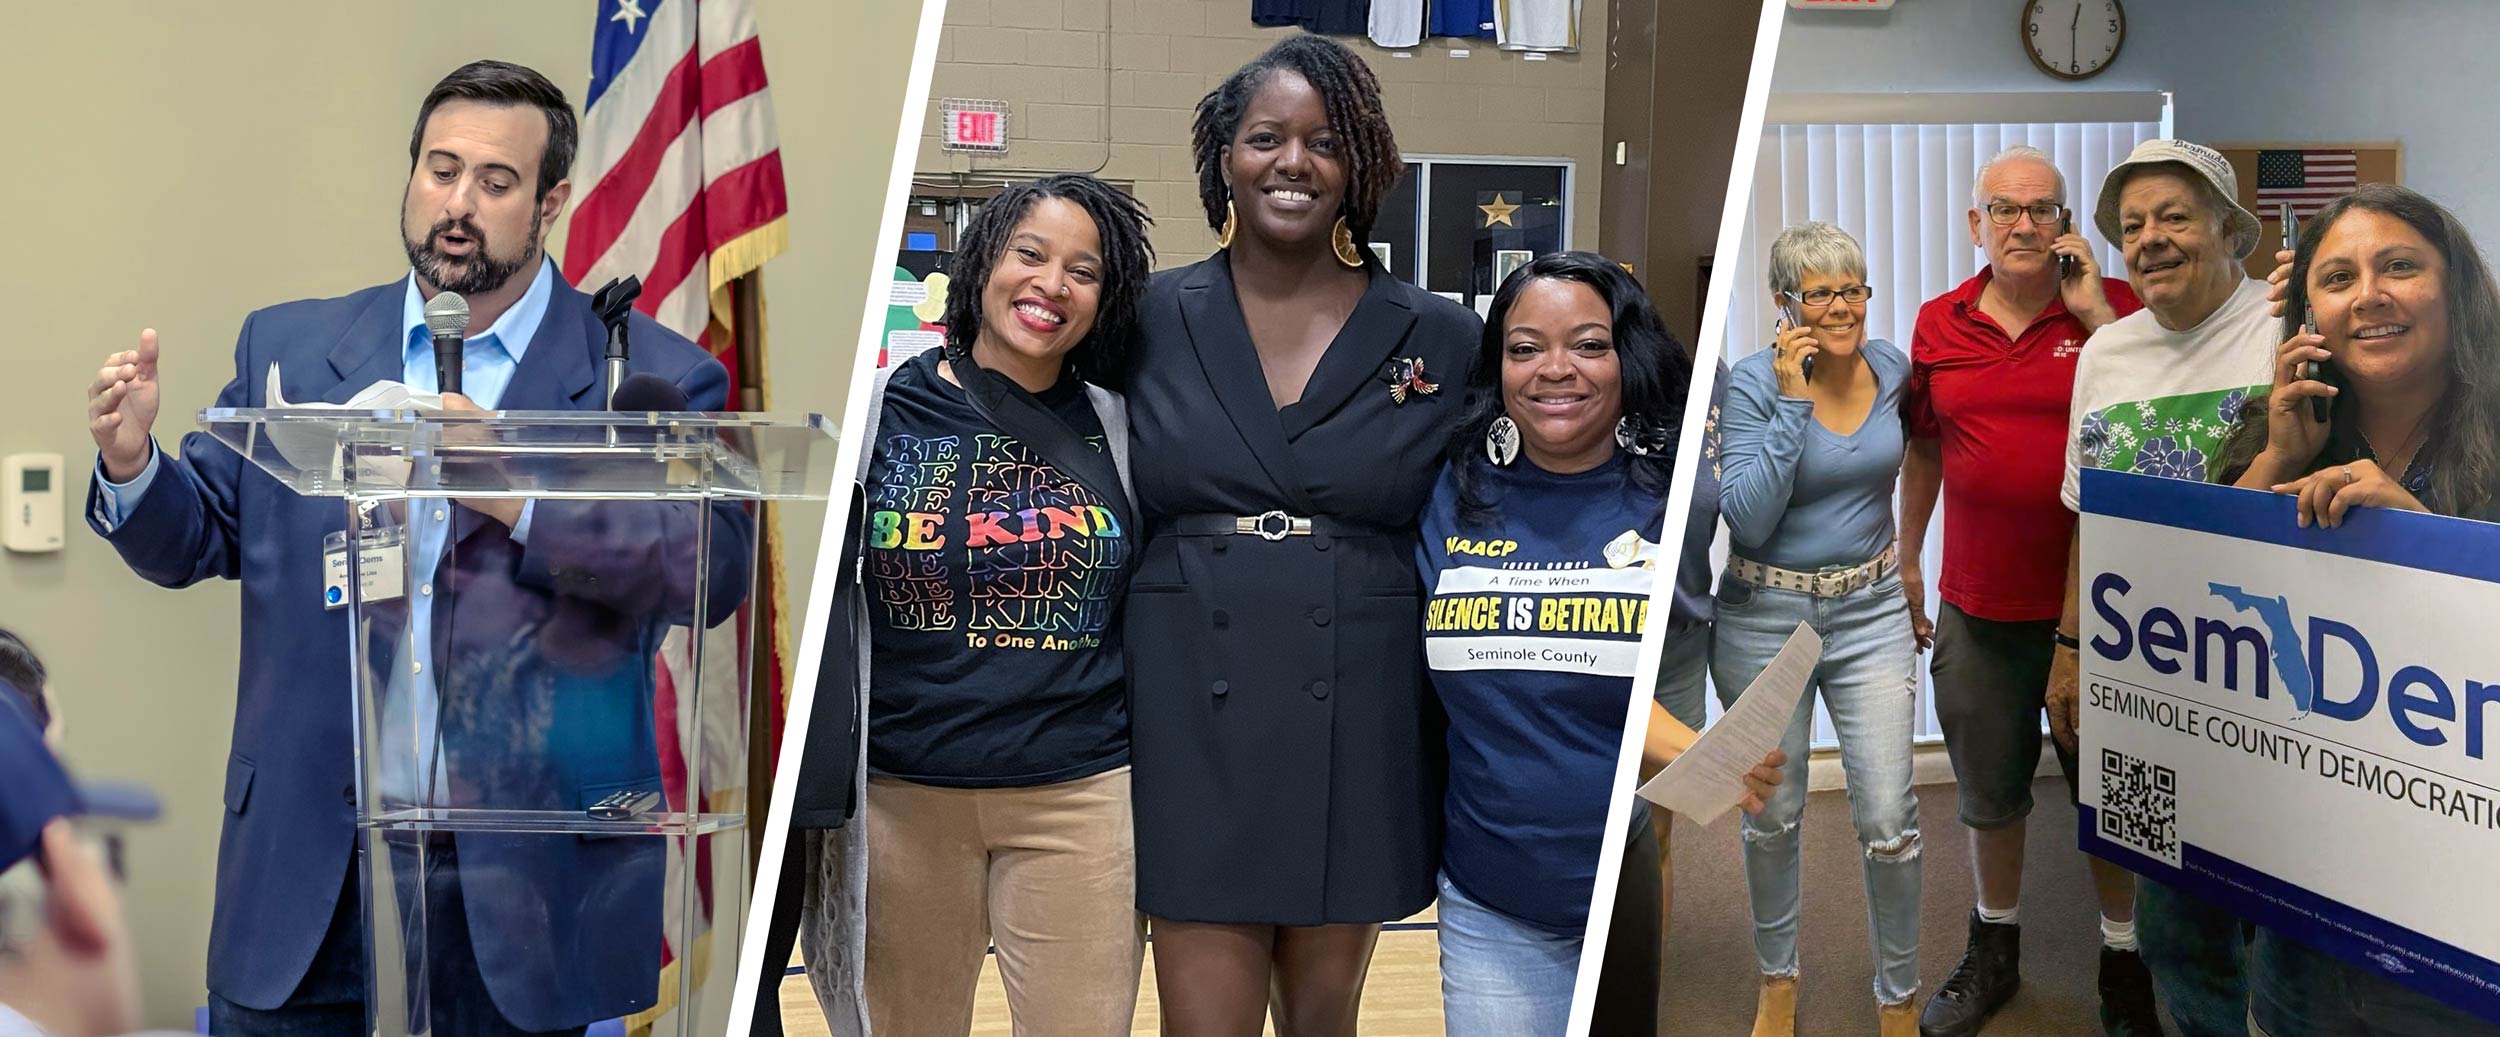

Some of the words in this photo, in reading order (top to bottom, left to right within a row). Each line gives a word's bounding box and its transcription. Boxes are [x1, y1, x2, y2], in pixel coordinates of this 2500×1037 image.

[2029, 23, 2039, 37] 9
[2108, 20, 2118, 33] 3
[2070, 61, 2080, 73] 6
[958, 111, 998, 143] EXIT
[887, 434, 960, 461] BE
[882, 460, 957, 487] BE
[876, 483, 951, 514] BE
[870, 510, 946, 550] BE
[965, 505, 1121, 547] KIND
[873, 551, 948, 580] BE
[967, 539, 1121, 574] KIND
[1446, 537, 1518, 557] NAACP
[880, 579, 954, 604] BE
[1489, 576, 1499, 585] A
[1508, 576, 1543, 587] Time
[1548, 576, 1590, 587] When
[888, 602, 957, 630] BE
[1426, 597, 1502, 632] SILENCE
[1507, 597, 1534, 631] IS
[966, 632, 988, 649] To
[994, 633, 1036, 649] One
[1041, 634, 1100, 651] Anothe
[2090, 572, 2270, 700] Sem
[1467, 648, 1536, 662] Seminole
[1542, 649, 1598, 666] County
[2089, 682, 2199, 737] SEMINOLE
[2206, 715, 2312, 771] COUNTY
